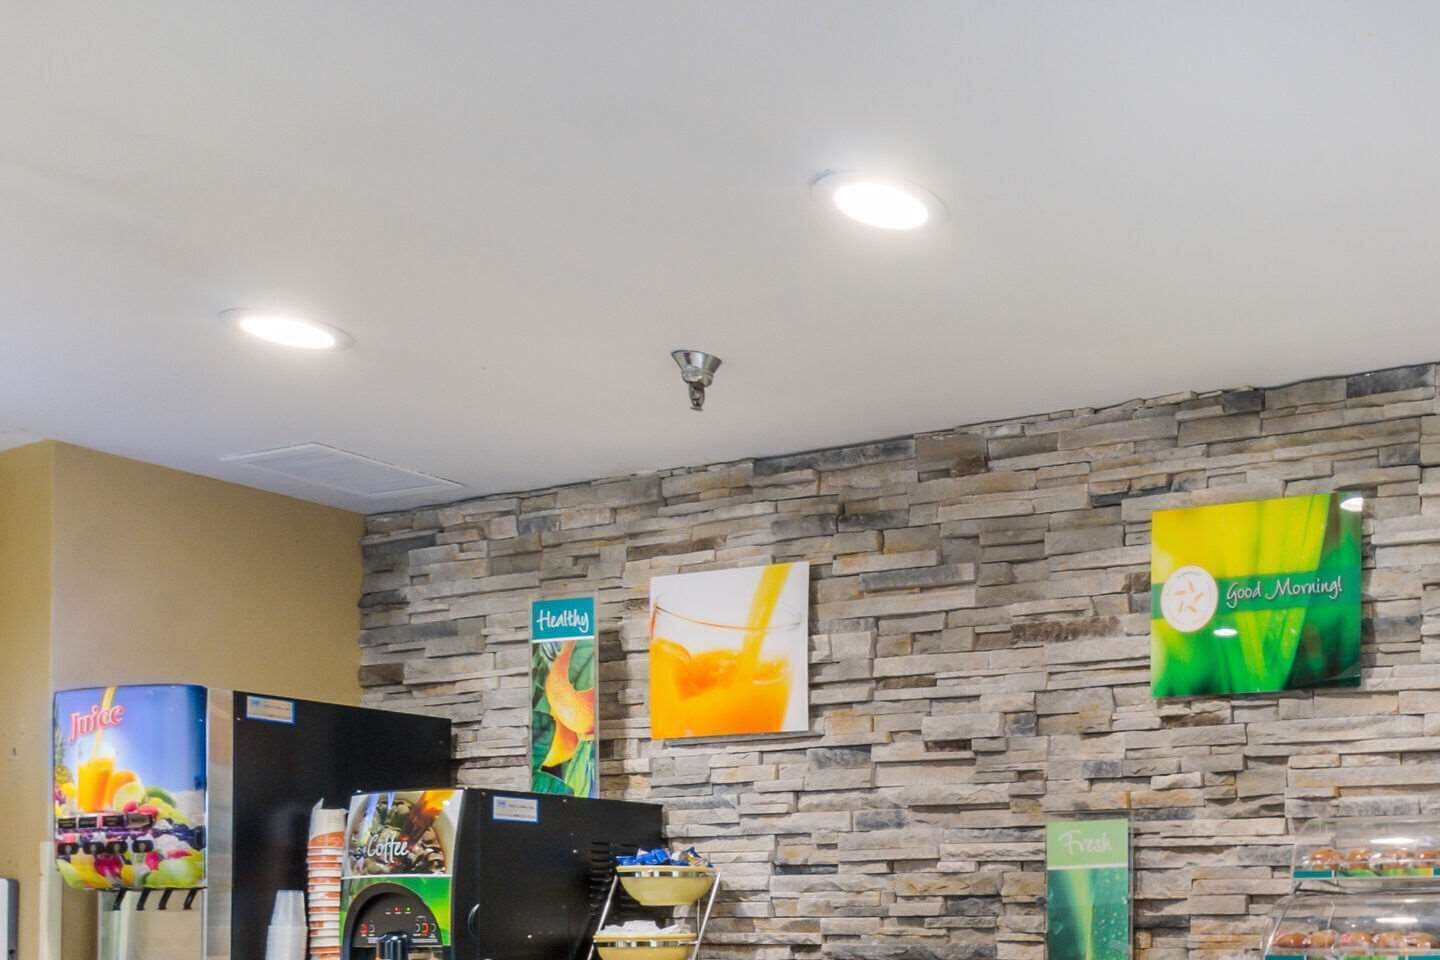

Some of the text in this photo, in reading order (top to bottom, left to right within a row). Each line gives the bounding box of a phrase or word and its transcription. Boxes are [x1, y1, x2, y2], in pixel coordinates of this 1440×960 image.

[1226, 576, 1342, 609] Good Morning!
[536, 608, 589, 633] Healthy
[69, 704, 126, 742] Juice
[367, 832, 409, 863] Coffee
